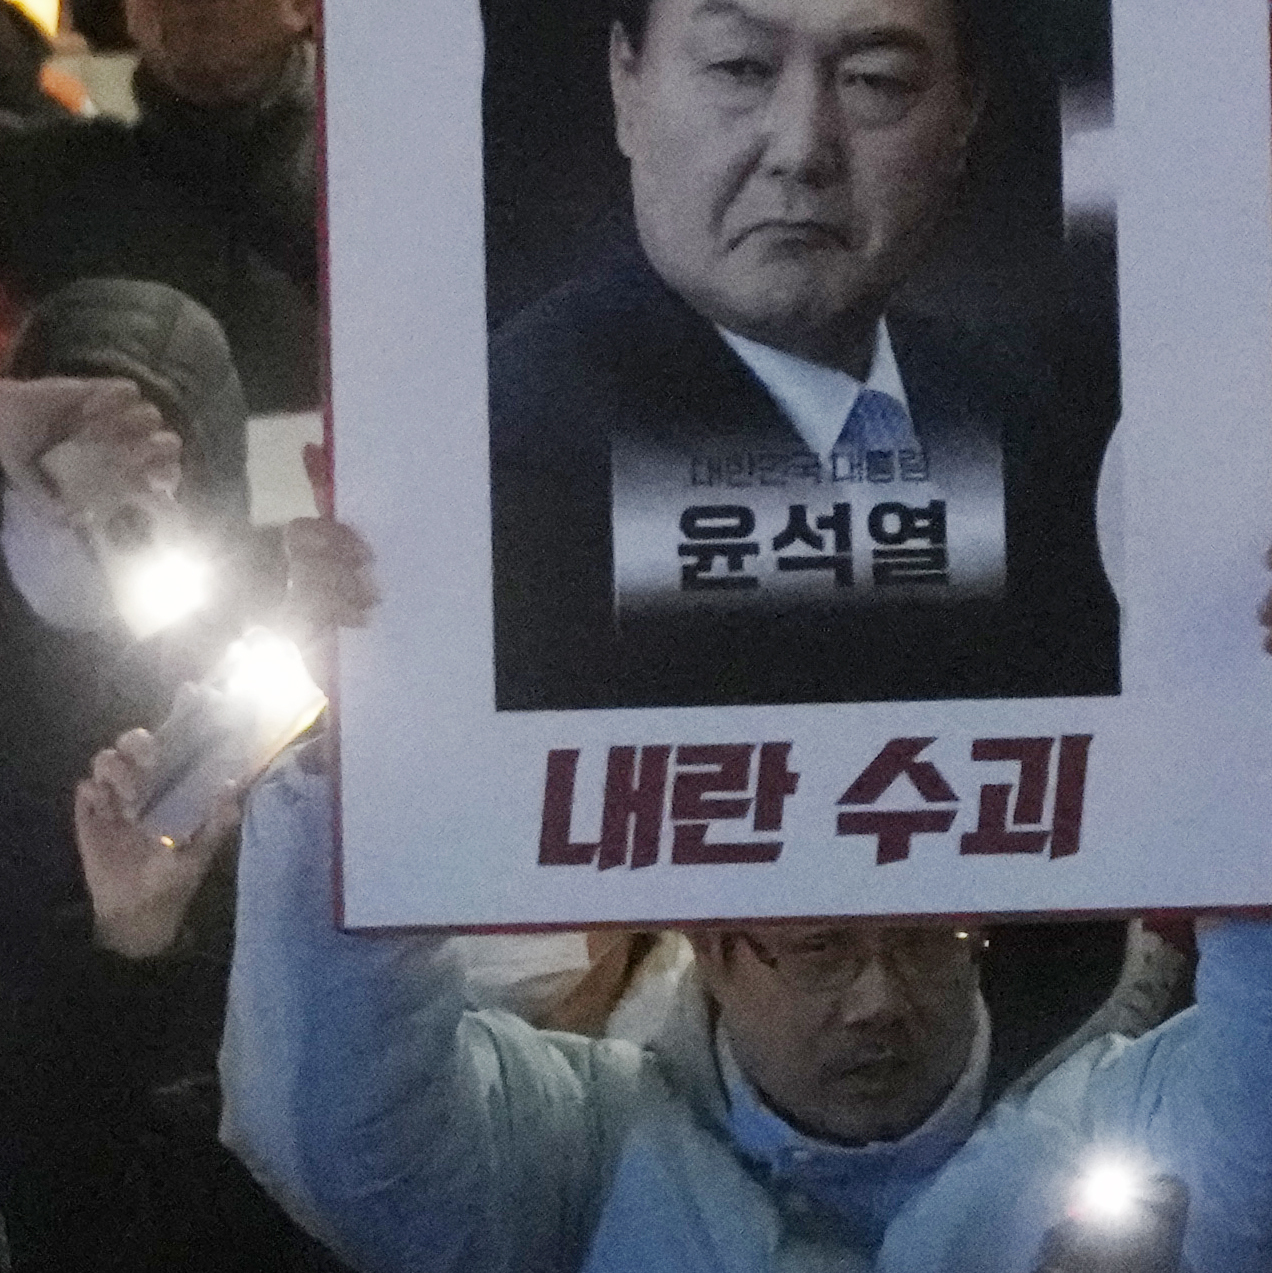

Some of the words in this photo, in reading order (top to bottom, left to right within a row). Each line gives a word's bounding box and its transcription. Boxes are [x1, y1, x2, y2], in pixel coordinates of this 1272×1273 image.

[831, 449, 929, 483] 대통령
[677, 499, 950, 591] 윤석열
[537, 740, 801, 872] 내란
[835, 733, 1095, 867] 수괴
